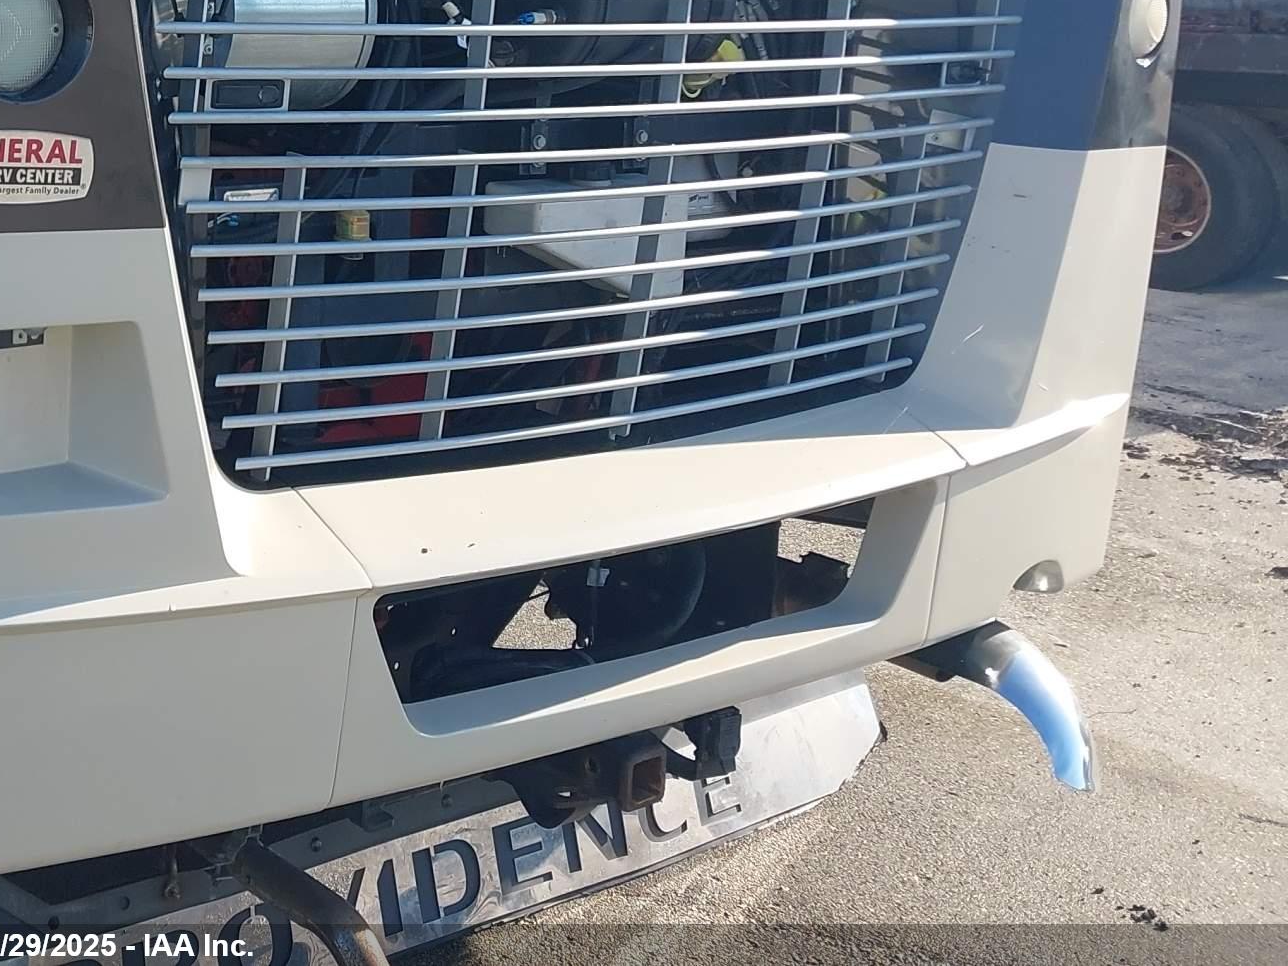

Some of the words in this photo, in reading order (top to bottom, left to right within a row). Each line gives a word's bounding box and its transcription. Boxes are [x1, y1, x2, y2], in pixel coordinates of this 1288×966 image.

[16, 169, 74, 184] CENTER
[25, 186, 51, 196] Family
[53, 187, 79, 195] Dealer
[52, 776, 742, 965] OIDENCE
